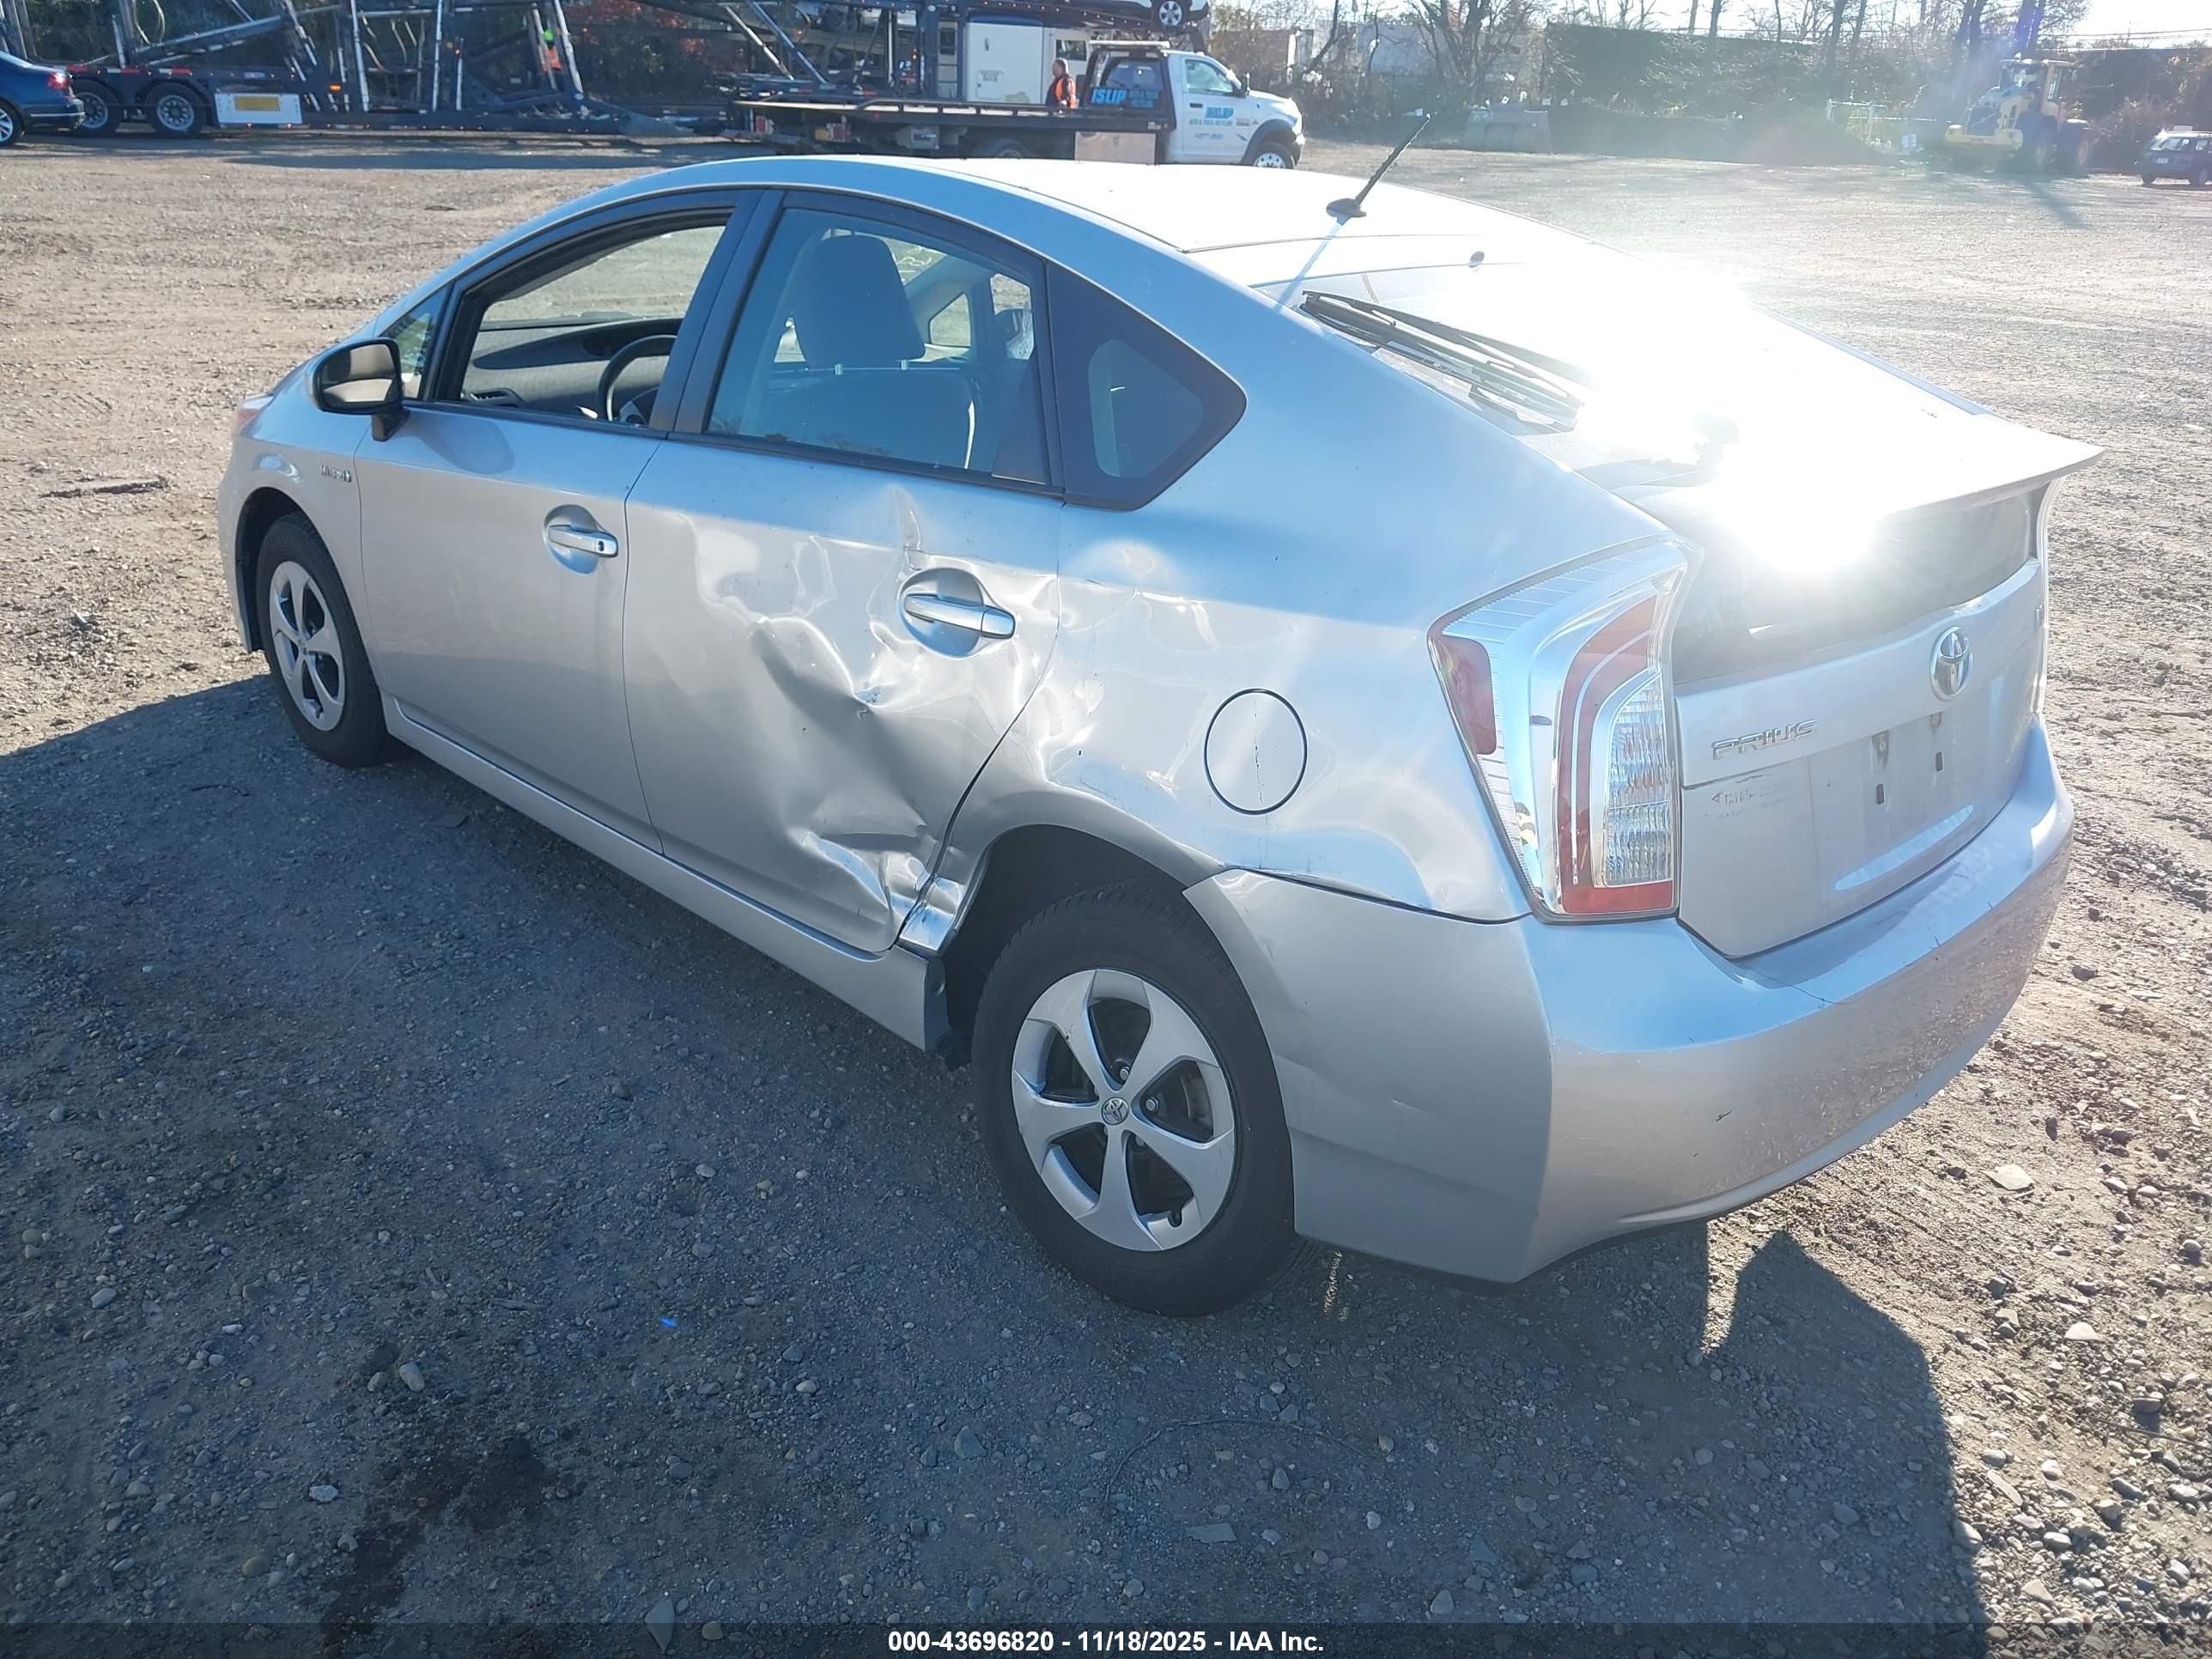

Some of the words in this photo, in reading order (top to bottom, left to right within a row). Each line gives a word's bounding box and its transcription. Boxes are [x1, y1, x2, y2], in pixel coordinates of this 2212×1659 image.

[1091, 88, 1127, 104] ISLIP
[1205, 106, 1234, 118] ISLIP
[1711, 719, 1818, 761] PRIUS
